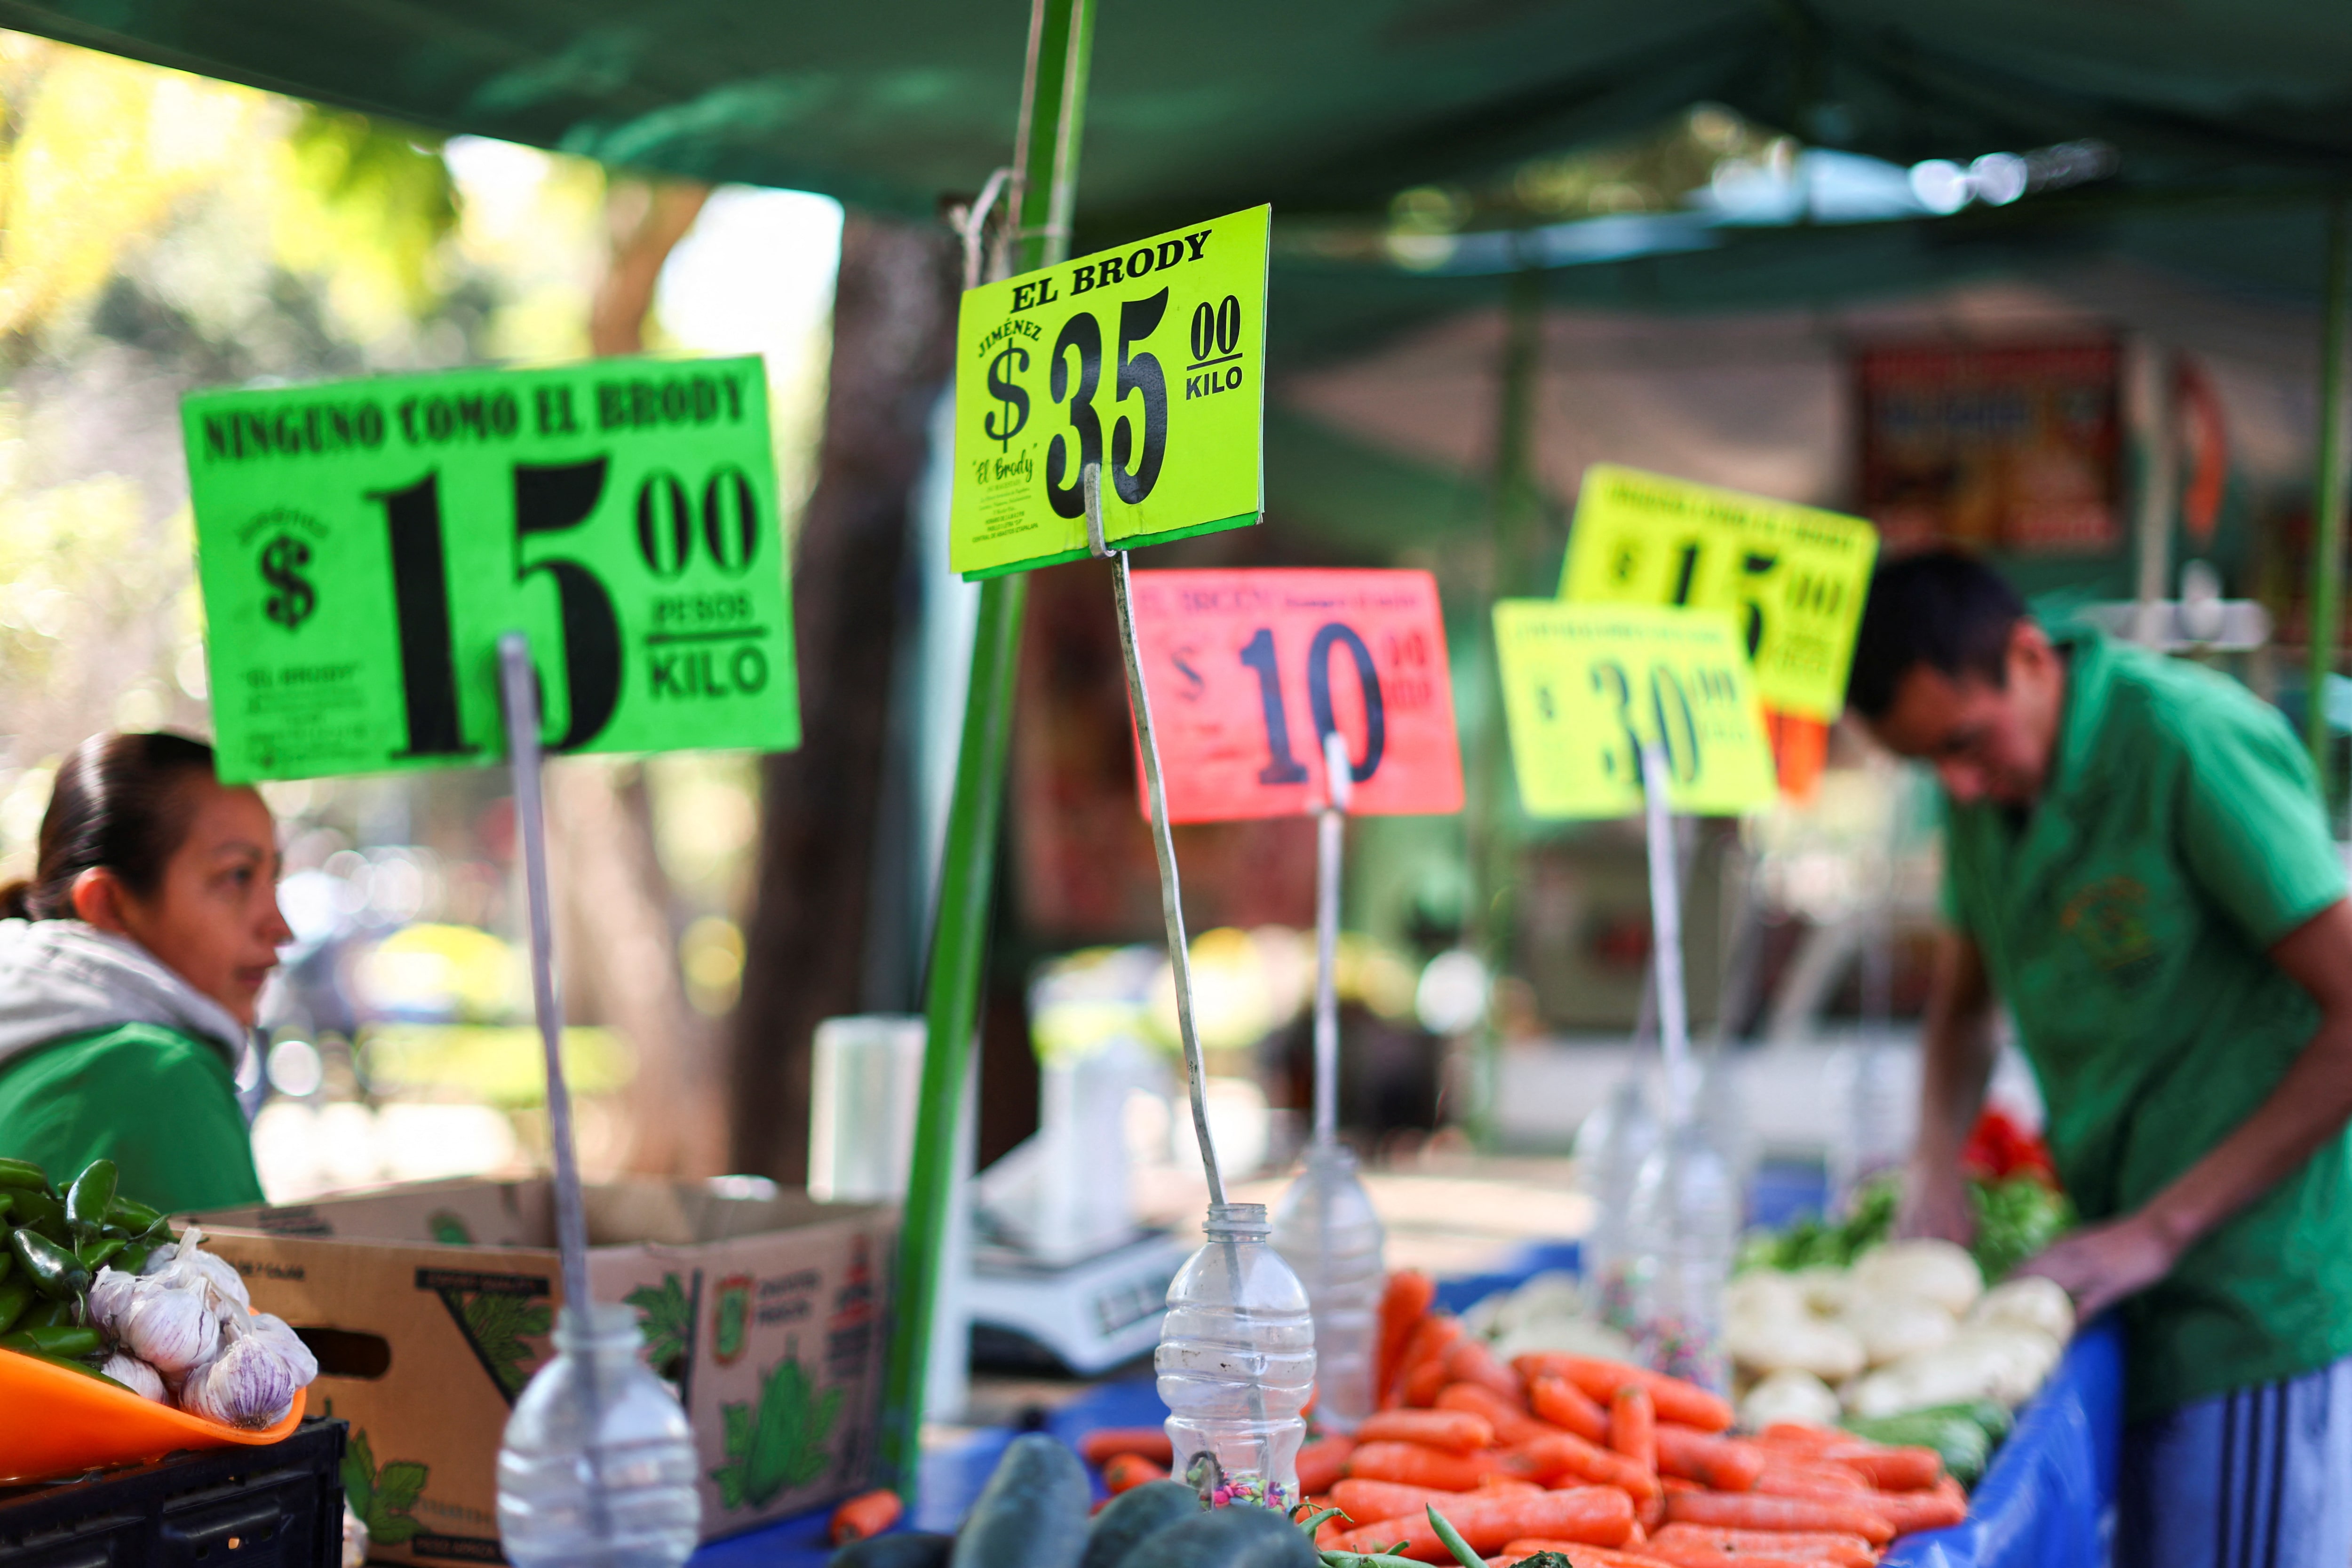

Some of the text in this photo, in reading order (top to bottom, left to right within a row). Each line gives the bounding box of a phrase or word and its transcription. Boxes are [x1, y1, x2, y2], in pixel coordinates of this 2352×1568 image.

[1010, 229, 1212, 314] EL BRODY
[978, 318, 1042, 358] JIMÉNEZ
[204, 373, 748, 461] NINGUNO COMO EL BRODY
[985, 285, 1240, 519] $ 35 00
[1185, 366, 1242, 401] KILO
[260, 450, 761, 760] $ 15 00
[652, 594, 754, 626] PESOS
[649, 647, 768, 699] KILO
[1239, 623, 1384, 785] 10
[1589, 662, 1702, 784] 30
